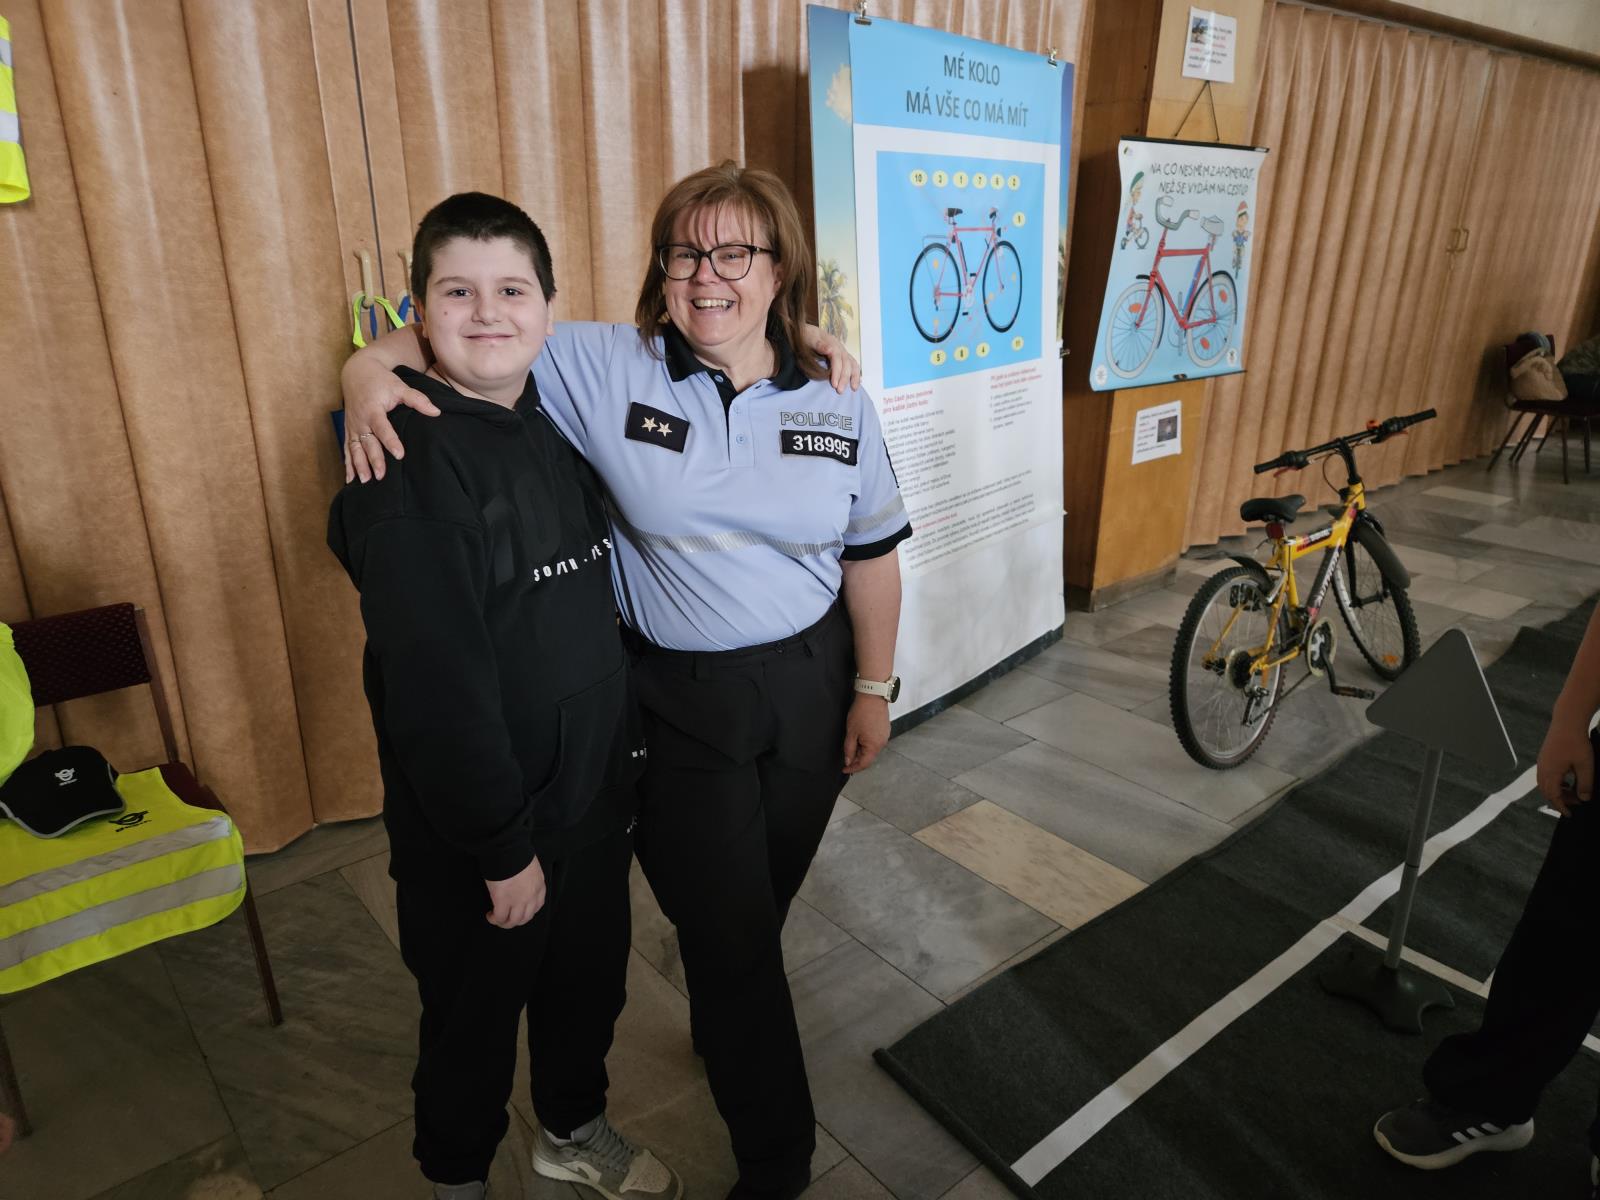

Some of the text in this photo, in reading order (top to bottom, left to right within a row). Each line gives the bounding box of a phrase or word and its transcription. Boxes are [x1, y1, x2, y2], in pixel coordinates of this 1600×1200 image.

[944, 52, 1000, 86] MÉ KOLO
[906, 86, 1028, 127] MÁ VŠE CO MÁ MÍT
[1163, 162, 1178, 175] CO
[780, 411, 853, 431] POLICE
[792, 434, 851, 459] 318995
